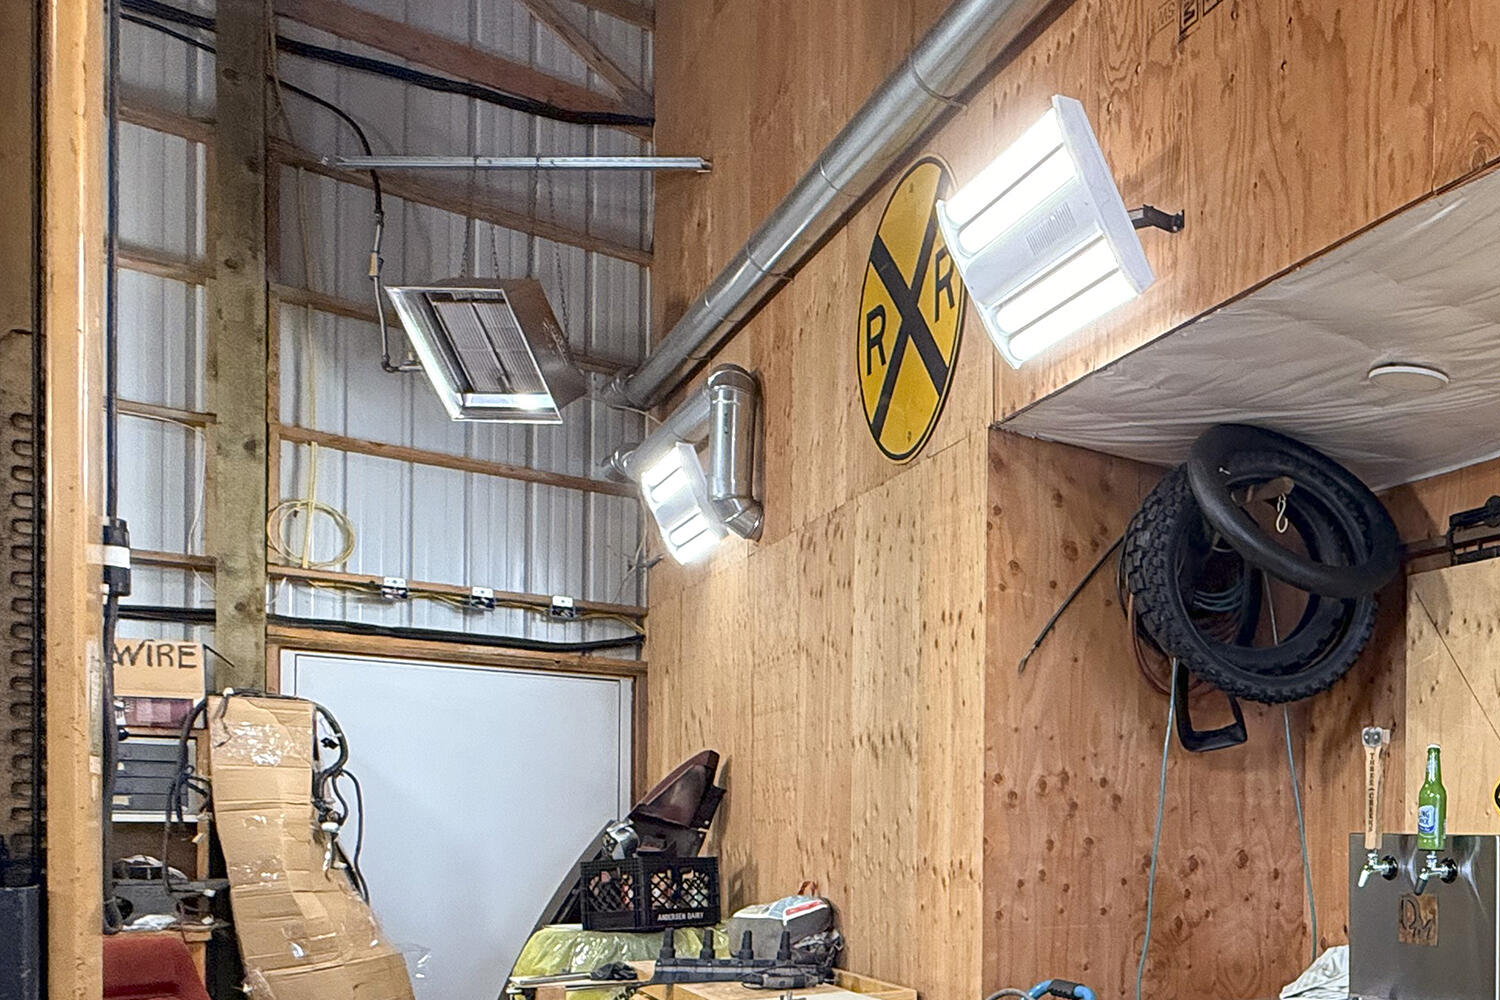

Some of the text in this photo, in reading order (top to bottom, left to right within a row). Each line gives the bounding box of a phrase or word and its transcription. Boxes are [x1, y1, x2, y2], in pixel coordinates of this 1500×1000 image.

[866, 304, 887, 376] R
[934, 244, 956, 324] R
[112, 638, 197, 669] WIRE
